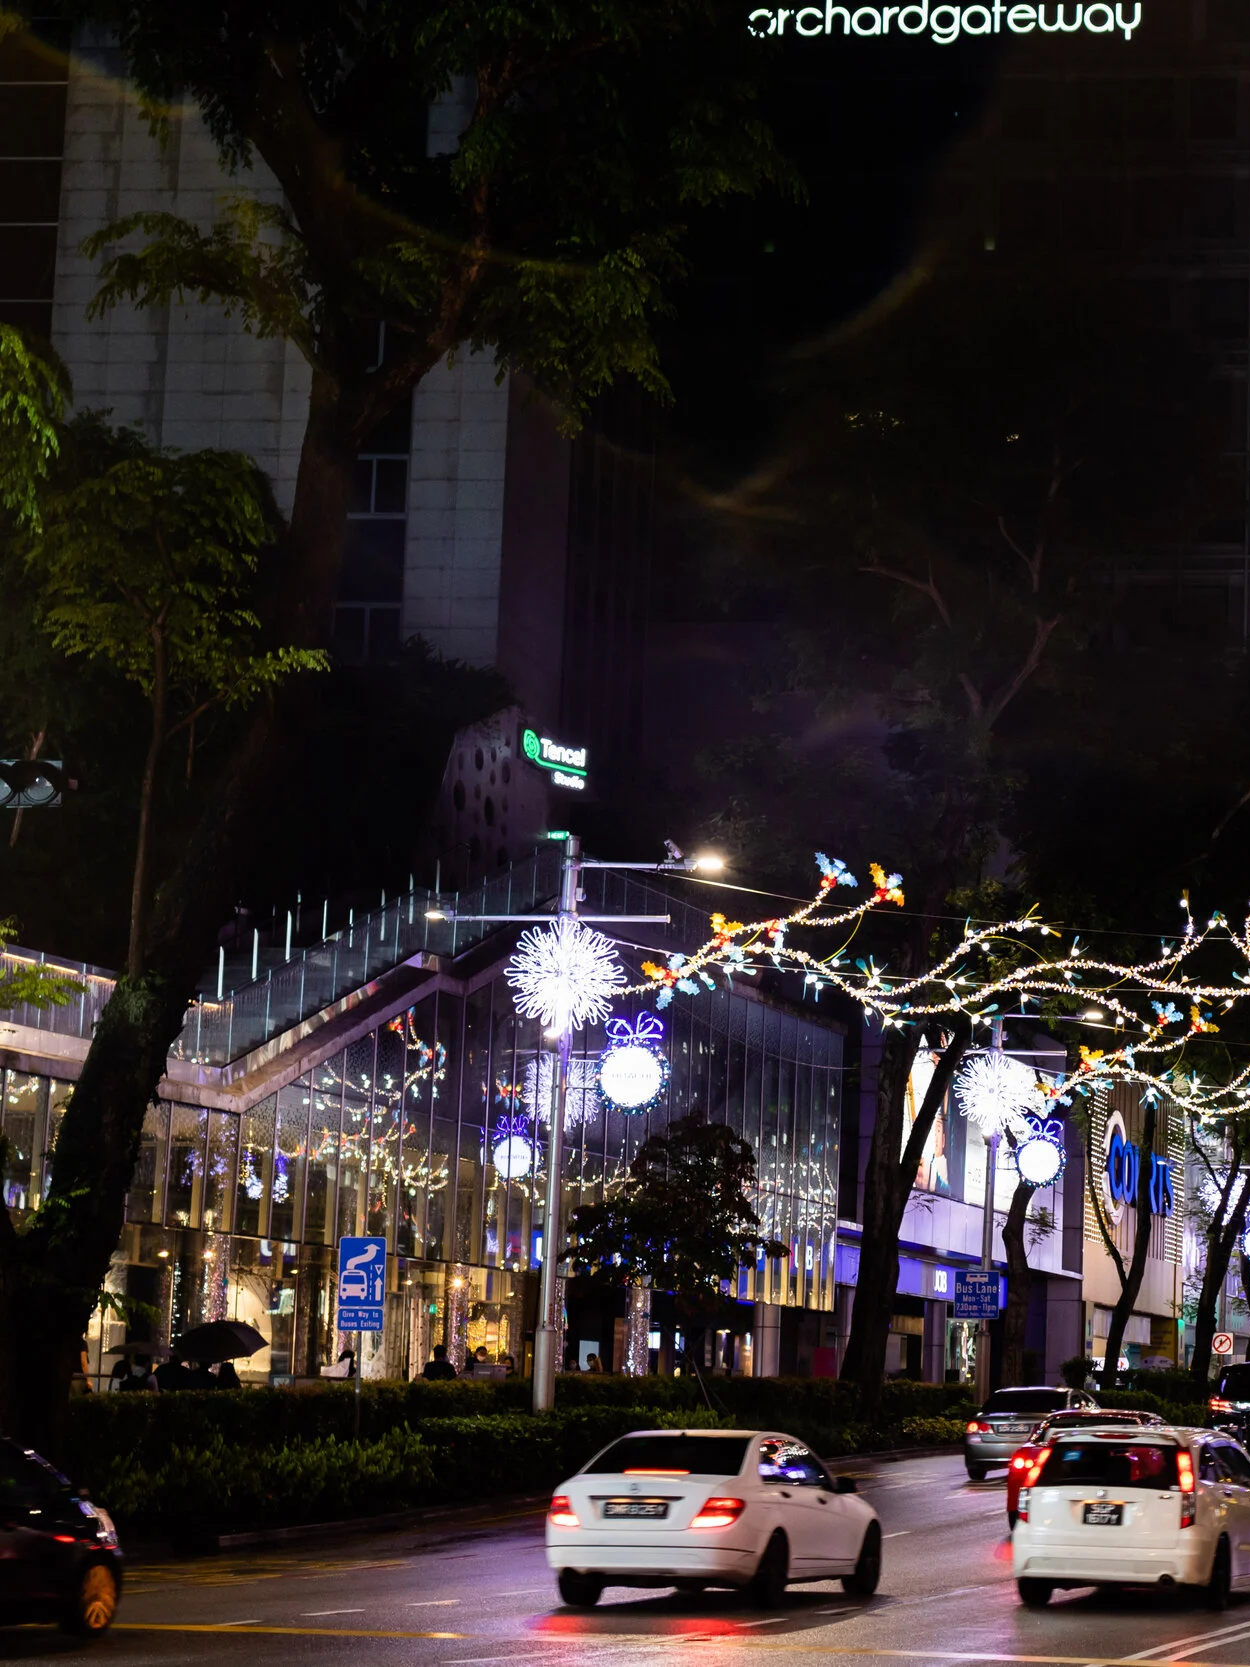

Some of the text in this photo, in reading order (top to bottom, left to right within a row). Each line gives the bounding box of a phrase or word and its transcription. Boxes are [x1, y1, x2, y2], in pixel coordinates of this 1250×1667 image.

[748, 0, 1142, 44] orchardgateway
[540, 738, 586, 767] Tencel
[956, 1283, 998, 1294] Bus Lane
